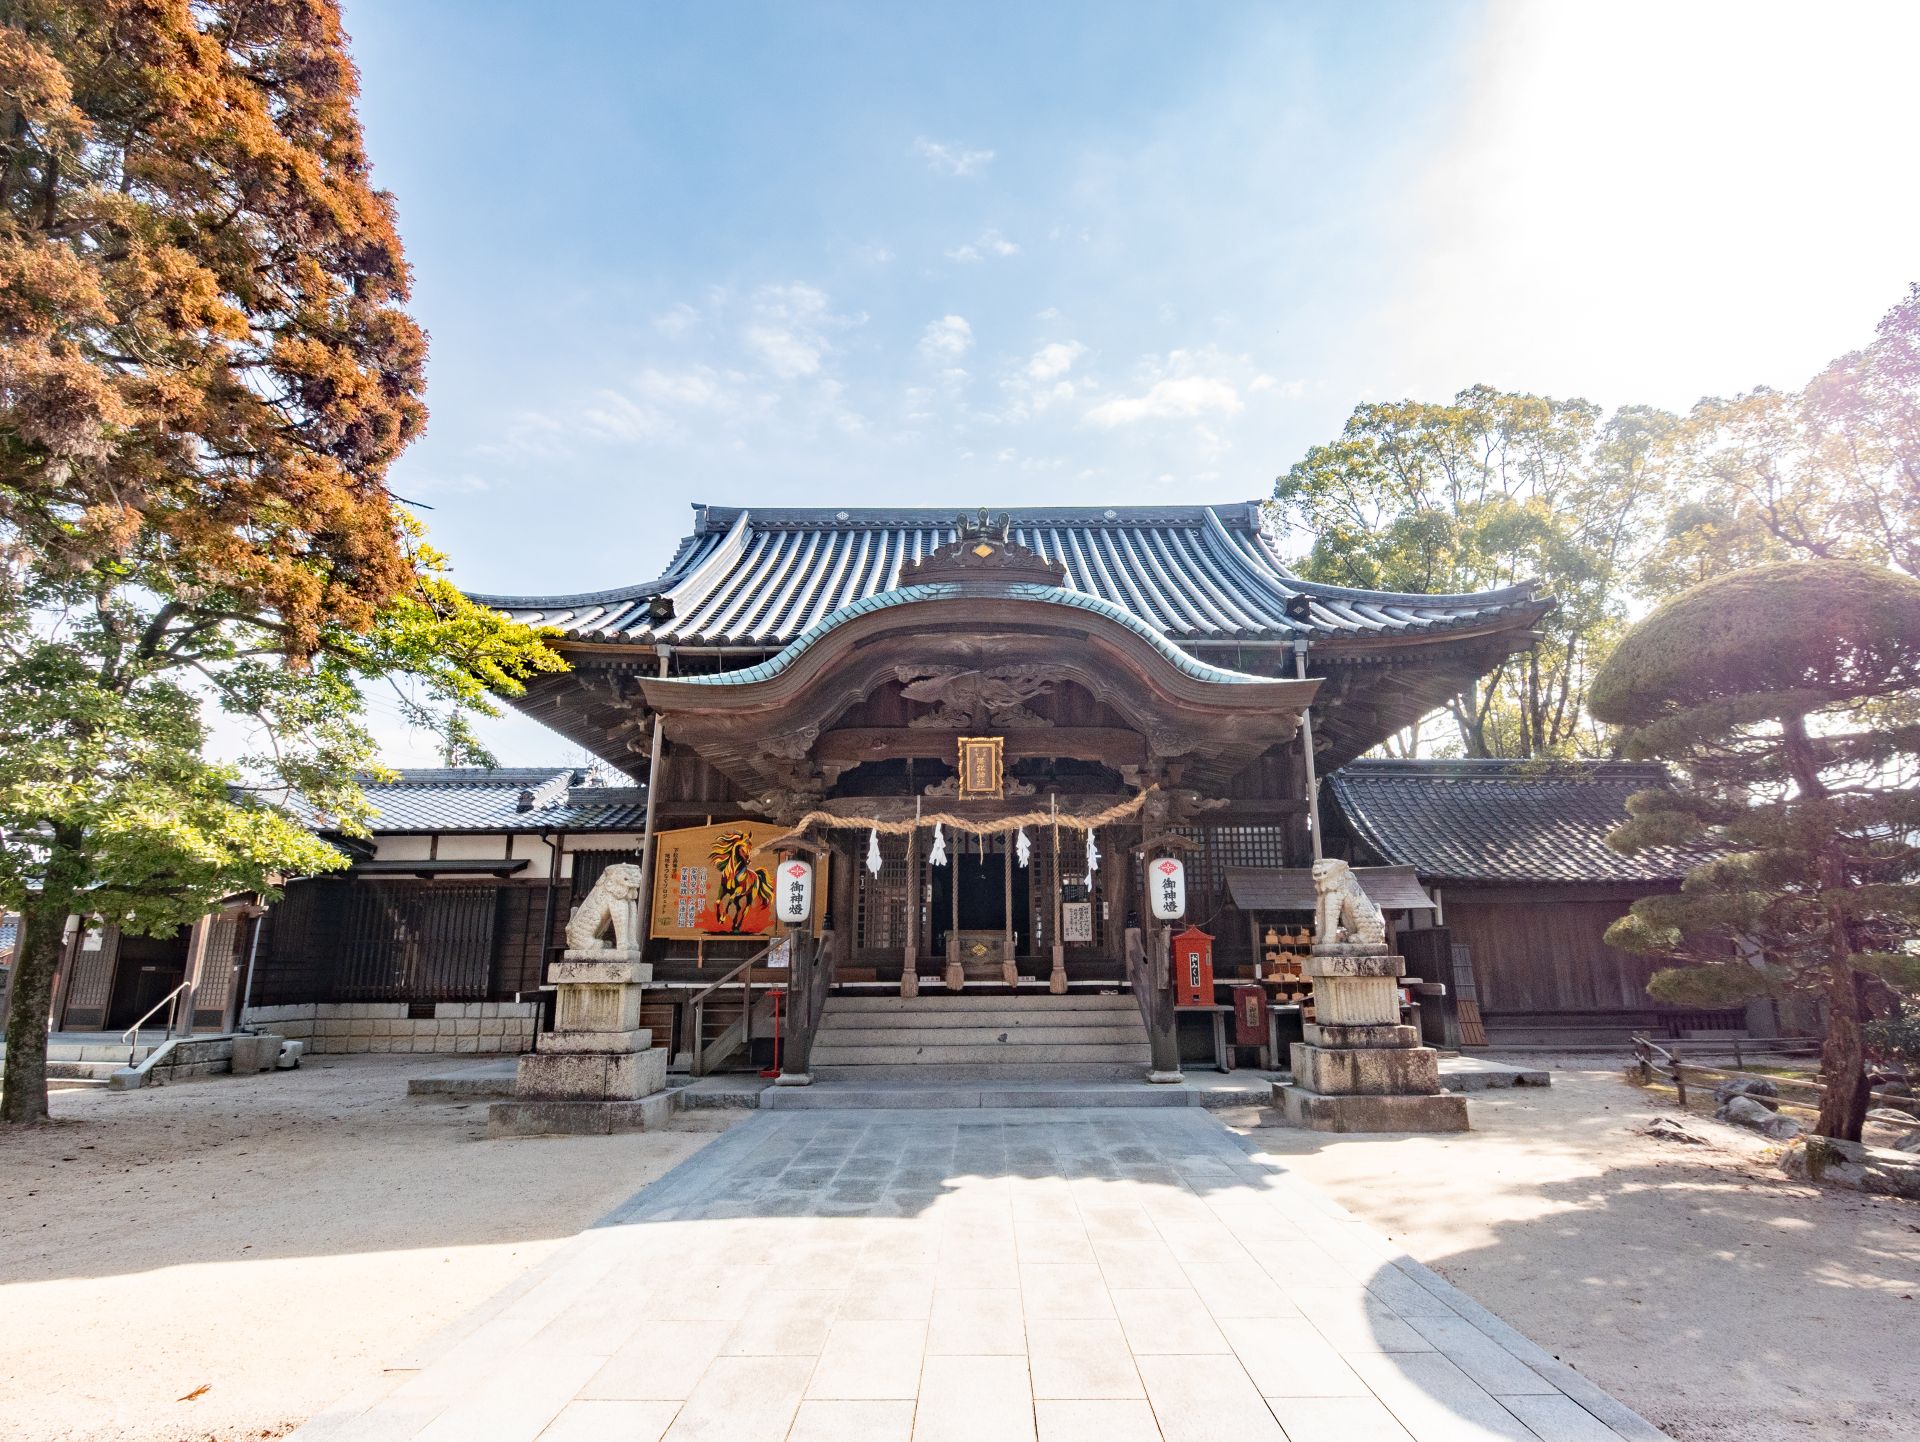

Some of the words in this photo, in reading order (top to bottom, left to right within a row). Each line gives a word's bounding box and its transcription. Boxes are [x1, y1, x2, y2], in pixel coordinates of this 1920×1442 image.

[789, 880, 804, 915] 御神燈
[1162, 877, 1178, 912] 御神燈
[1191, 954, 1199, 986] おみくじ
